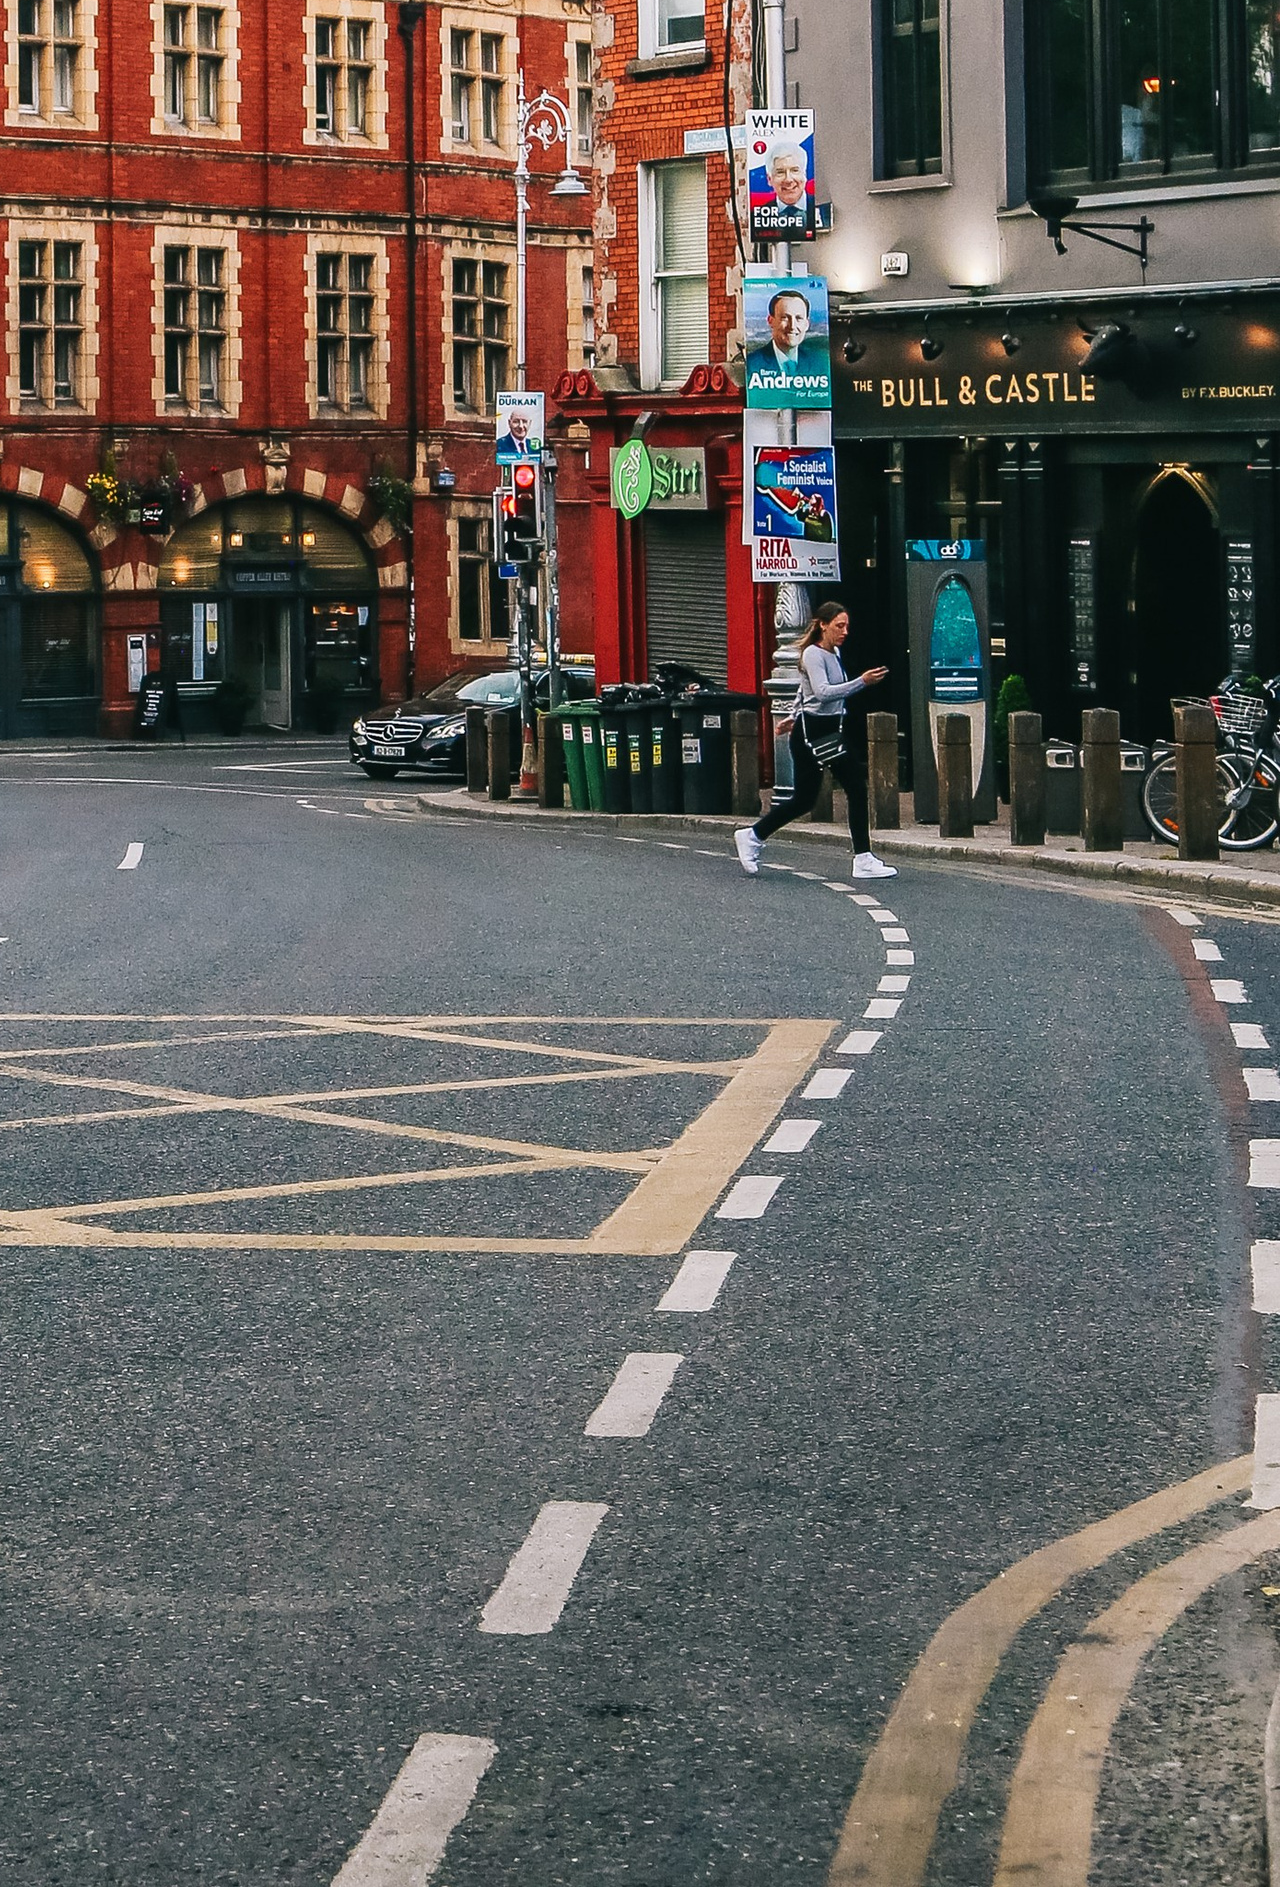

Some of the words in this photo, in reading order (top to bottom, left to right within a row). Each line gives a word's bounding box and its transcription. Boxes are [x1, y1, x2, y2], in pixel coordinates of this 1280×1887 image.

[751, 115, 809, 128] WHITE
[752, 129, 775, 137] ALEX
[753, 206, 779, 217] FOR
[754, 216, 803, 228] EUROPE
[760, 369, 777, 377] Barry
[748, 372, 829, 389] Andrews
[853, 380, 873, 392] THE
[881, 377, 948, 407] BULL
[958, 375, 977, 405] &
[985, 372, 1095, 404] CASTLE
[1182, 387, 1197, 399] BY
[499, 398, 537, 406] DURKAN
[789, 460, 827, 473] Socialist
[777, 472, 815, 485] Feminist
[816, 475, 833, 486] Voice
[766, 514, 772, 532] 1
[760, 538, 792, 557] RITA
[756, 558, 798, 570] HARROLD
[236, 572, 255, 582] COPPER
[257, 572, 272, 581] ALLEY
